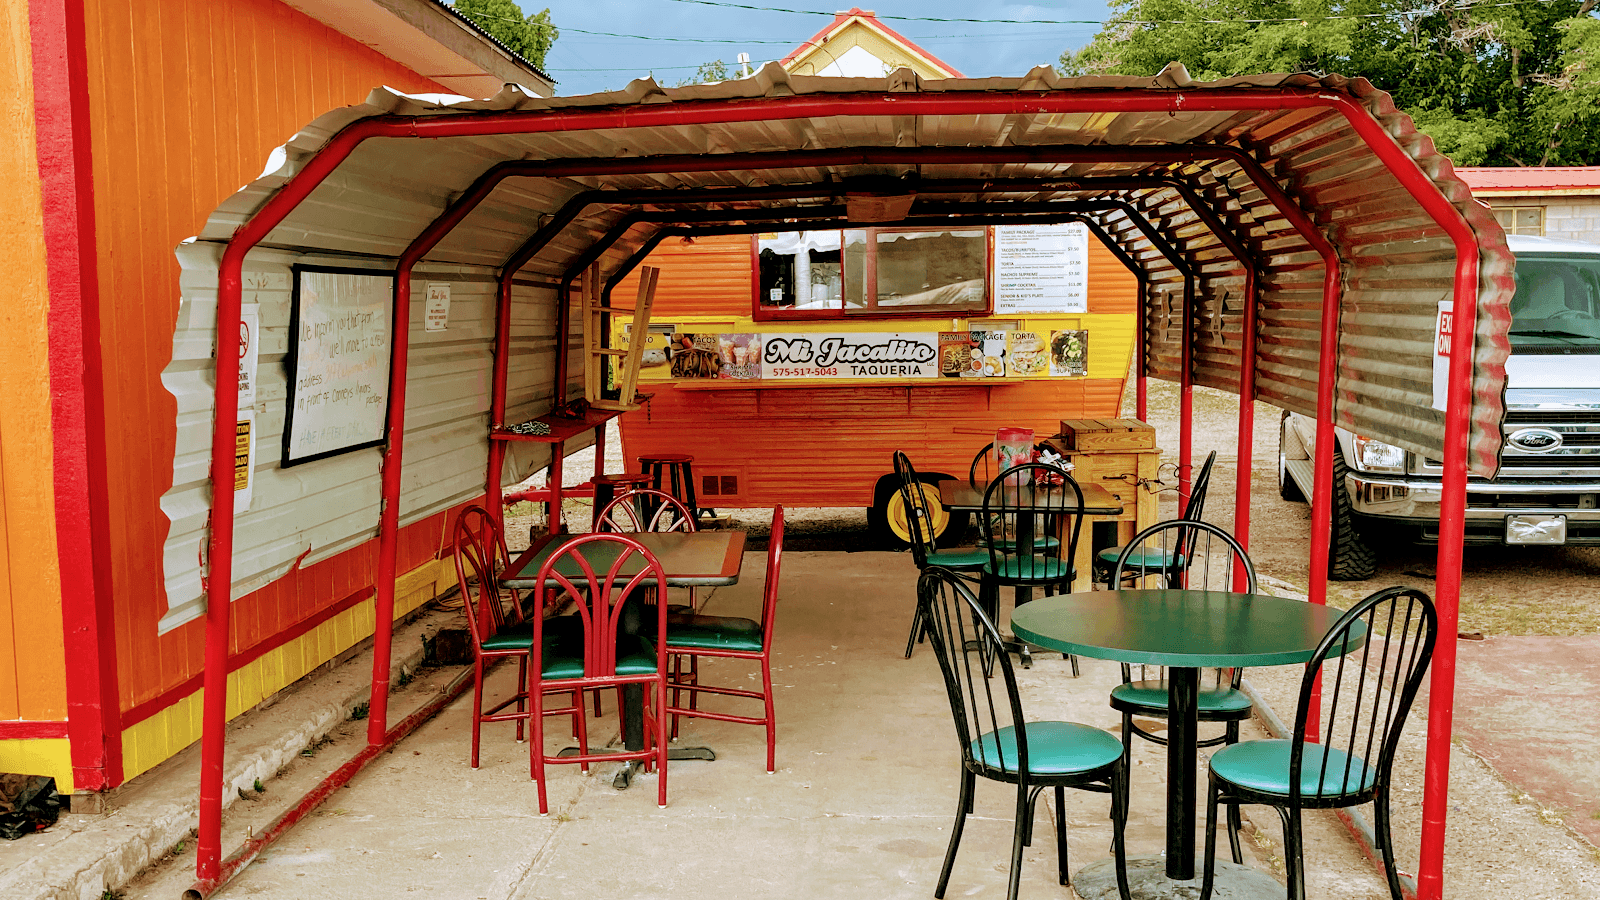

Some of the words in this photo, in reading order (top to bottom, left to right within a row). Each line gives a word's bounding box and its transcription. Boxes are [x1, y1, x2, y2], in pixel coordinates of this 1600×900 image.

[1441, 314, 1454, 334] EXI
[621, 336, 654, 344] BUTO
[693, 336, 717, 344] TACOS
[969, 333, 1004, 341] PACKAGE
[1011, 332, 1036, 340] TORTA
[1438, 335, 1452, 354] ON
[764, 337, 815, 364] Mi
[815, 337, 937, 368] Jacalito
[773, 367, 838, 376] 575-517-5043
[850, 365, 922, 376] TAQUERIA
[238, 382, 250, 391] APING
[1524, 435, 1550, 445] Ford
